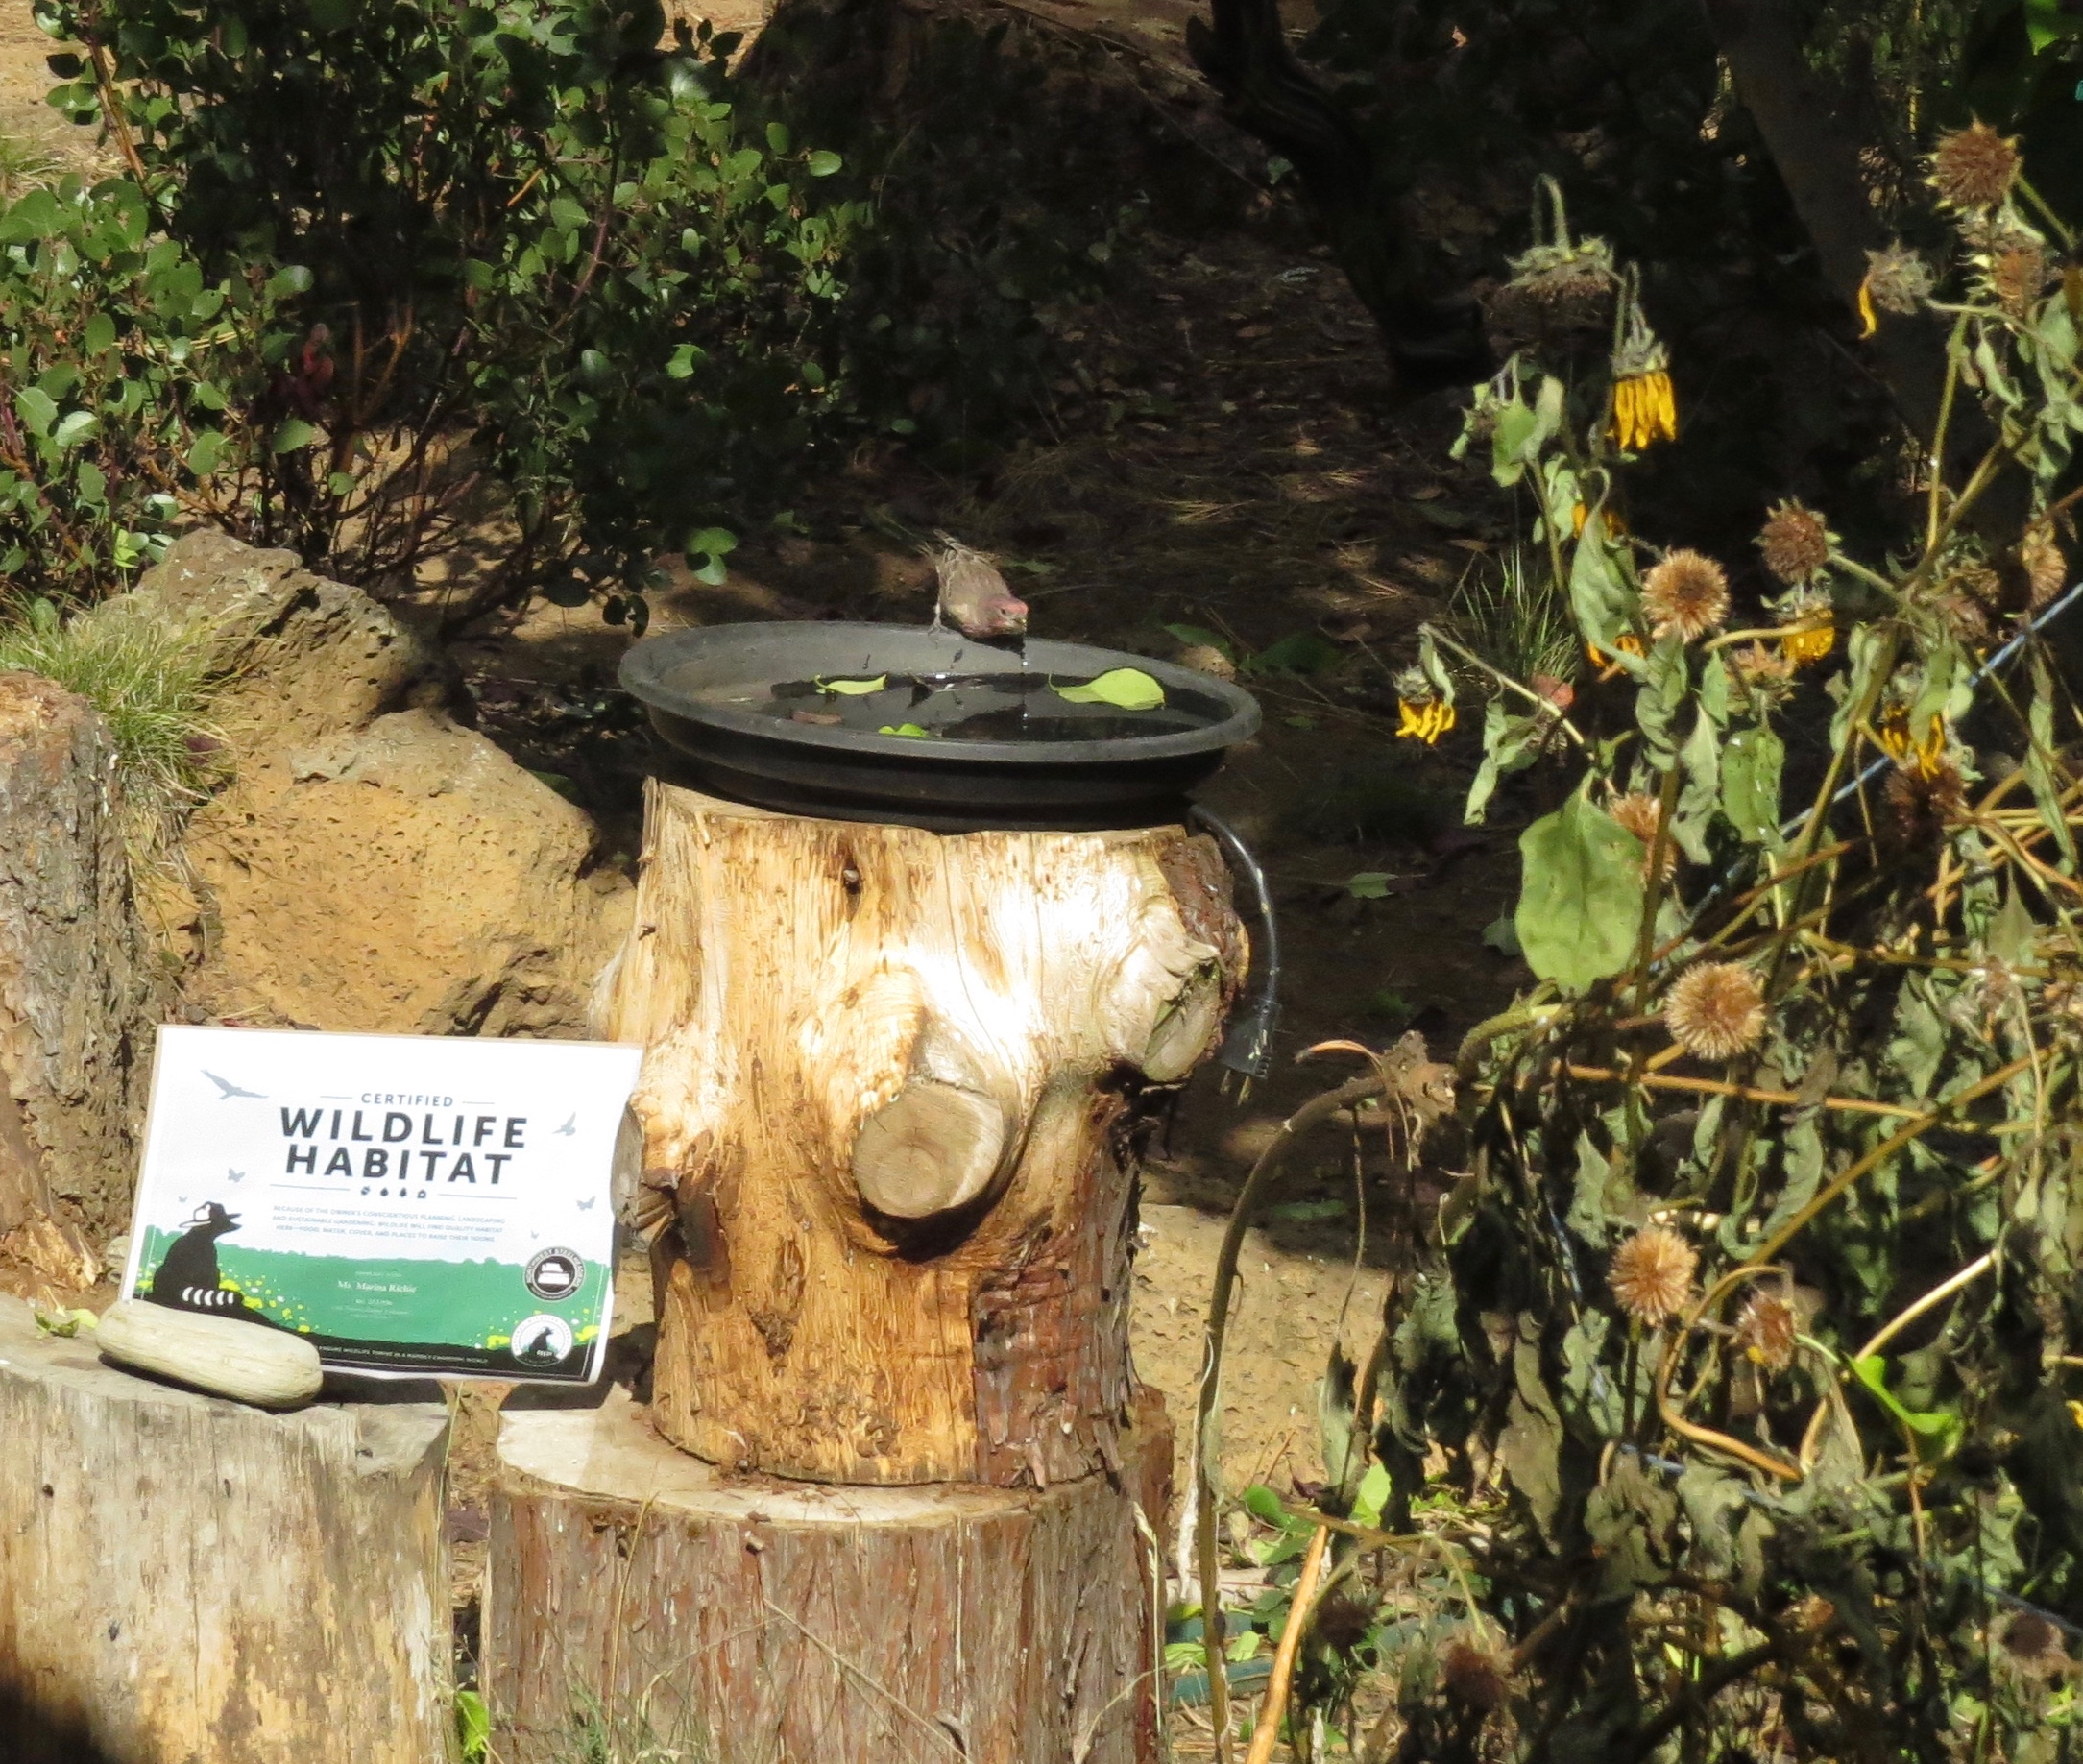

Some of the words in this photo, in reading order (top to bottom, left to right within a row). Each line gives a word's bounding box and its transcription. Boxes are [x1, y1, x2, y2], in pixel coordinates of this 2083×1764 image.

[361, 1093, 454, 1107] CERTIFIED
[280, 1107, 528, 1148] WILDLIFE
[286, 1144, 513, 1185] HABITAT
[273, 1205, 303, 1214] BECAUSE
[458, 1216, 506, 1224] LANDSCAPING
